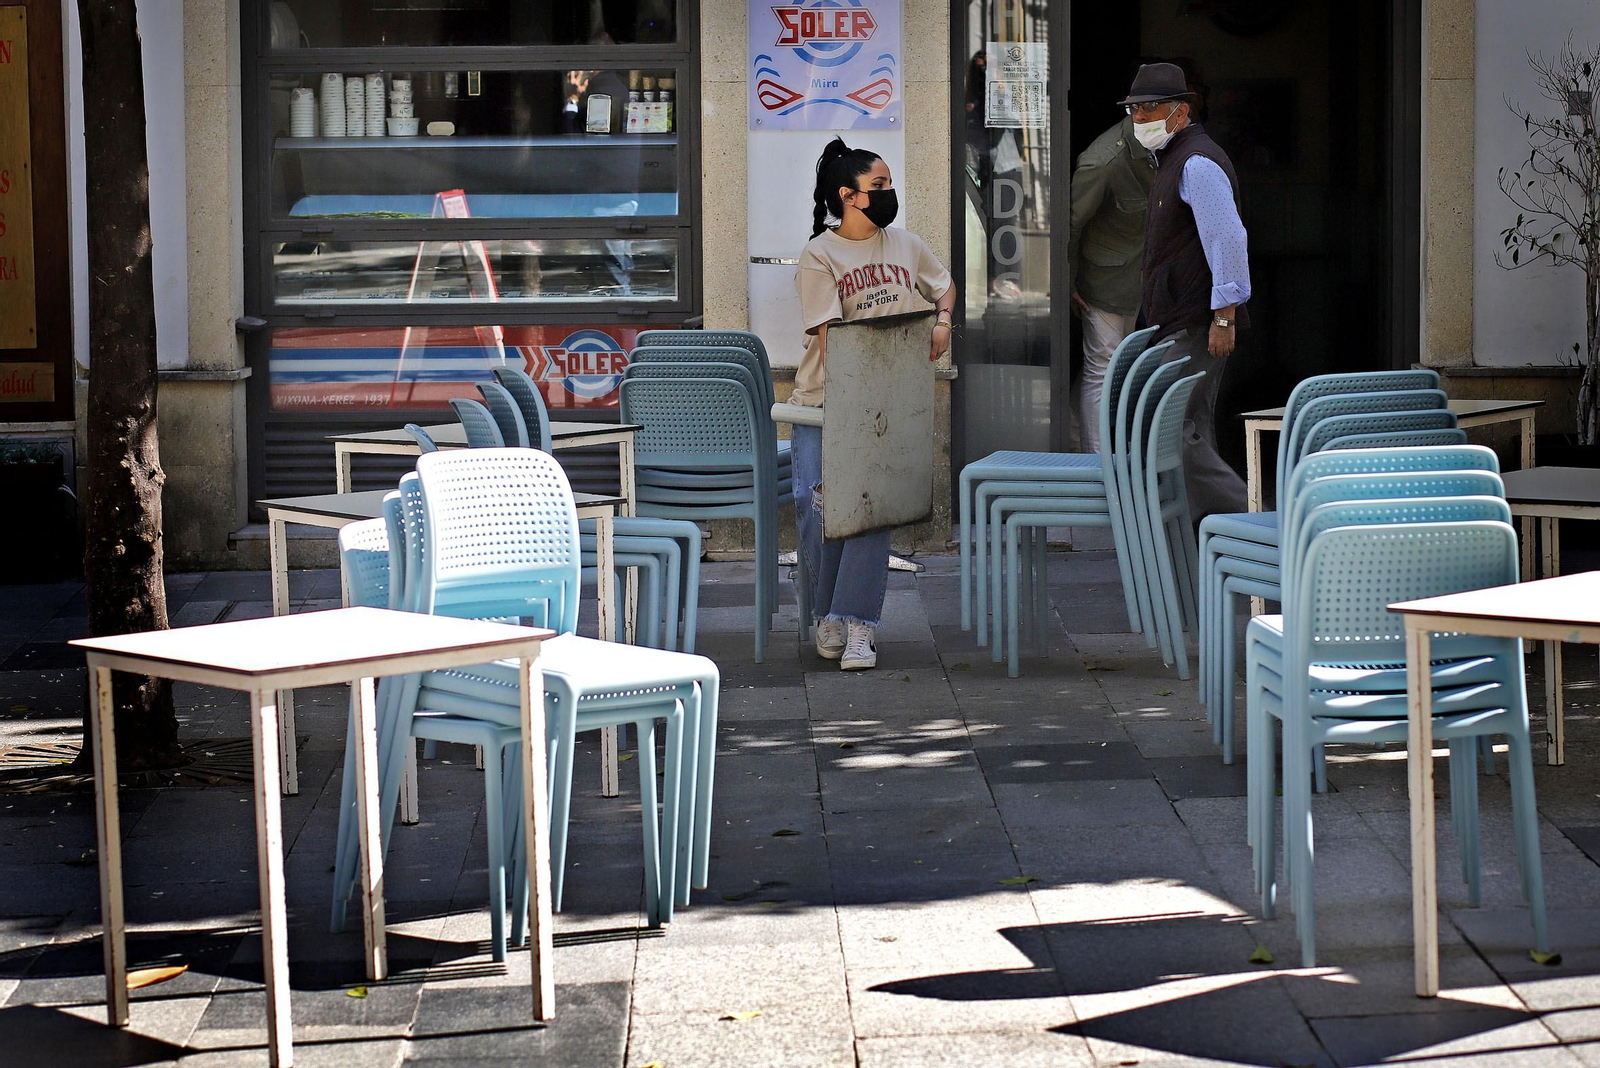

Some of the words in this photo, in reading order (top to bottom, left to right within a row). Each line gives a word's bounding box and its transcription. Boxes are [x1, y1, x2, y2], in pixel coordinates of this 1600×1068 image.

[776, 8, 875, 44] SOLER
[811, 79, 838, 88] Mira
[856, 302, 873, 311] NEW
[874, 294, 899, 306] YORK
[547, 349, 630, 378] SOLER
[0, 368, 37, 395] alud
[364, 394, 390, 406] 1937
